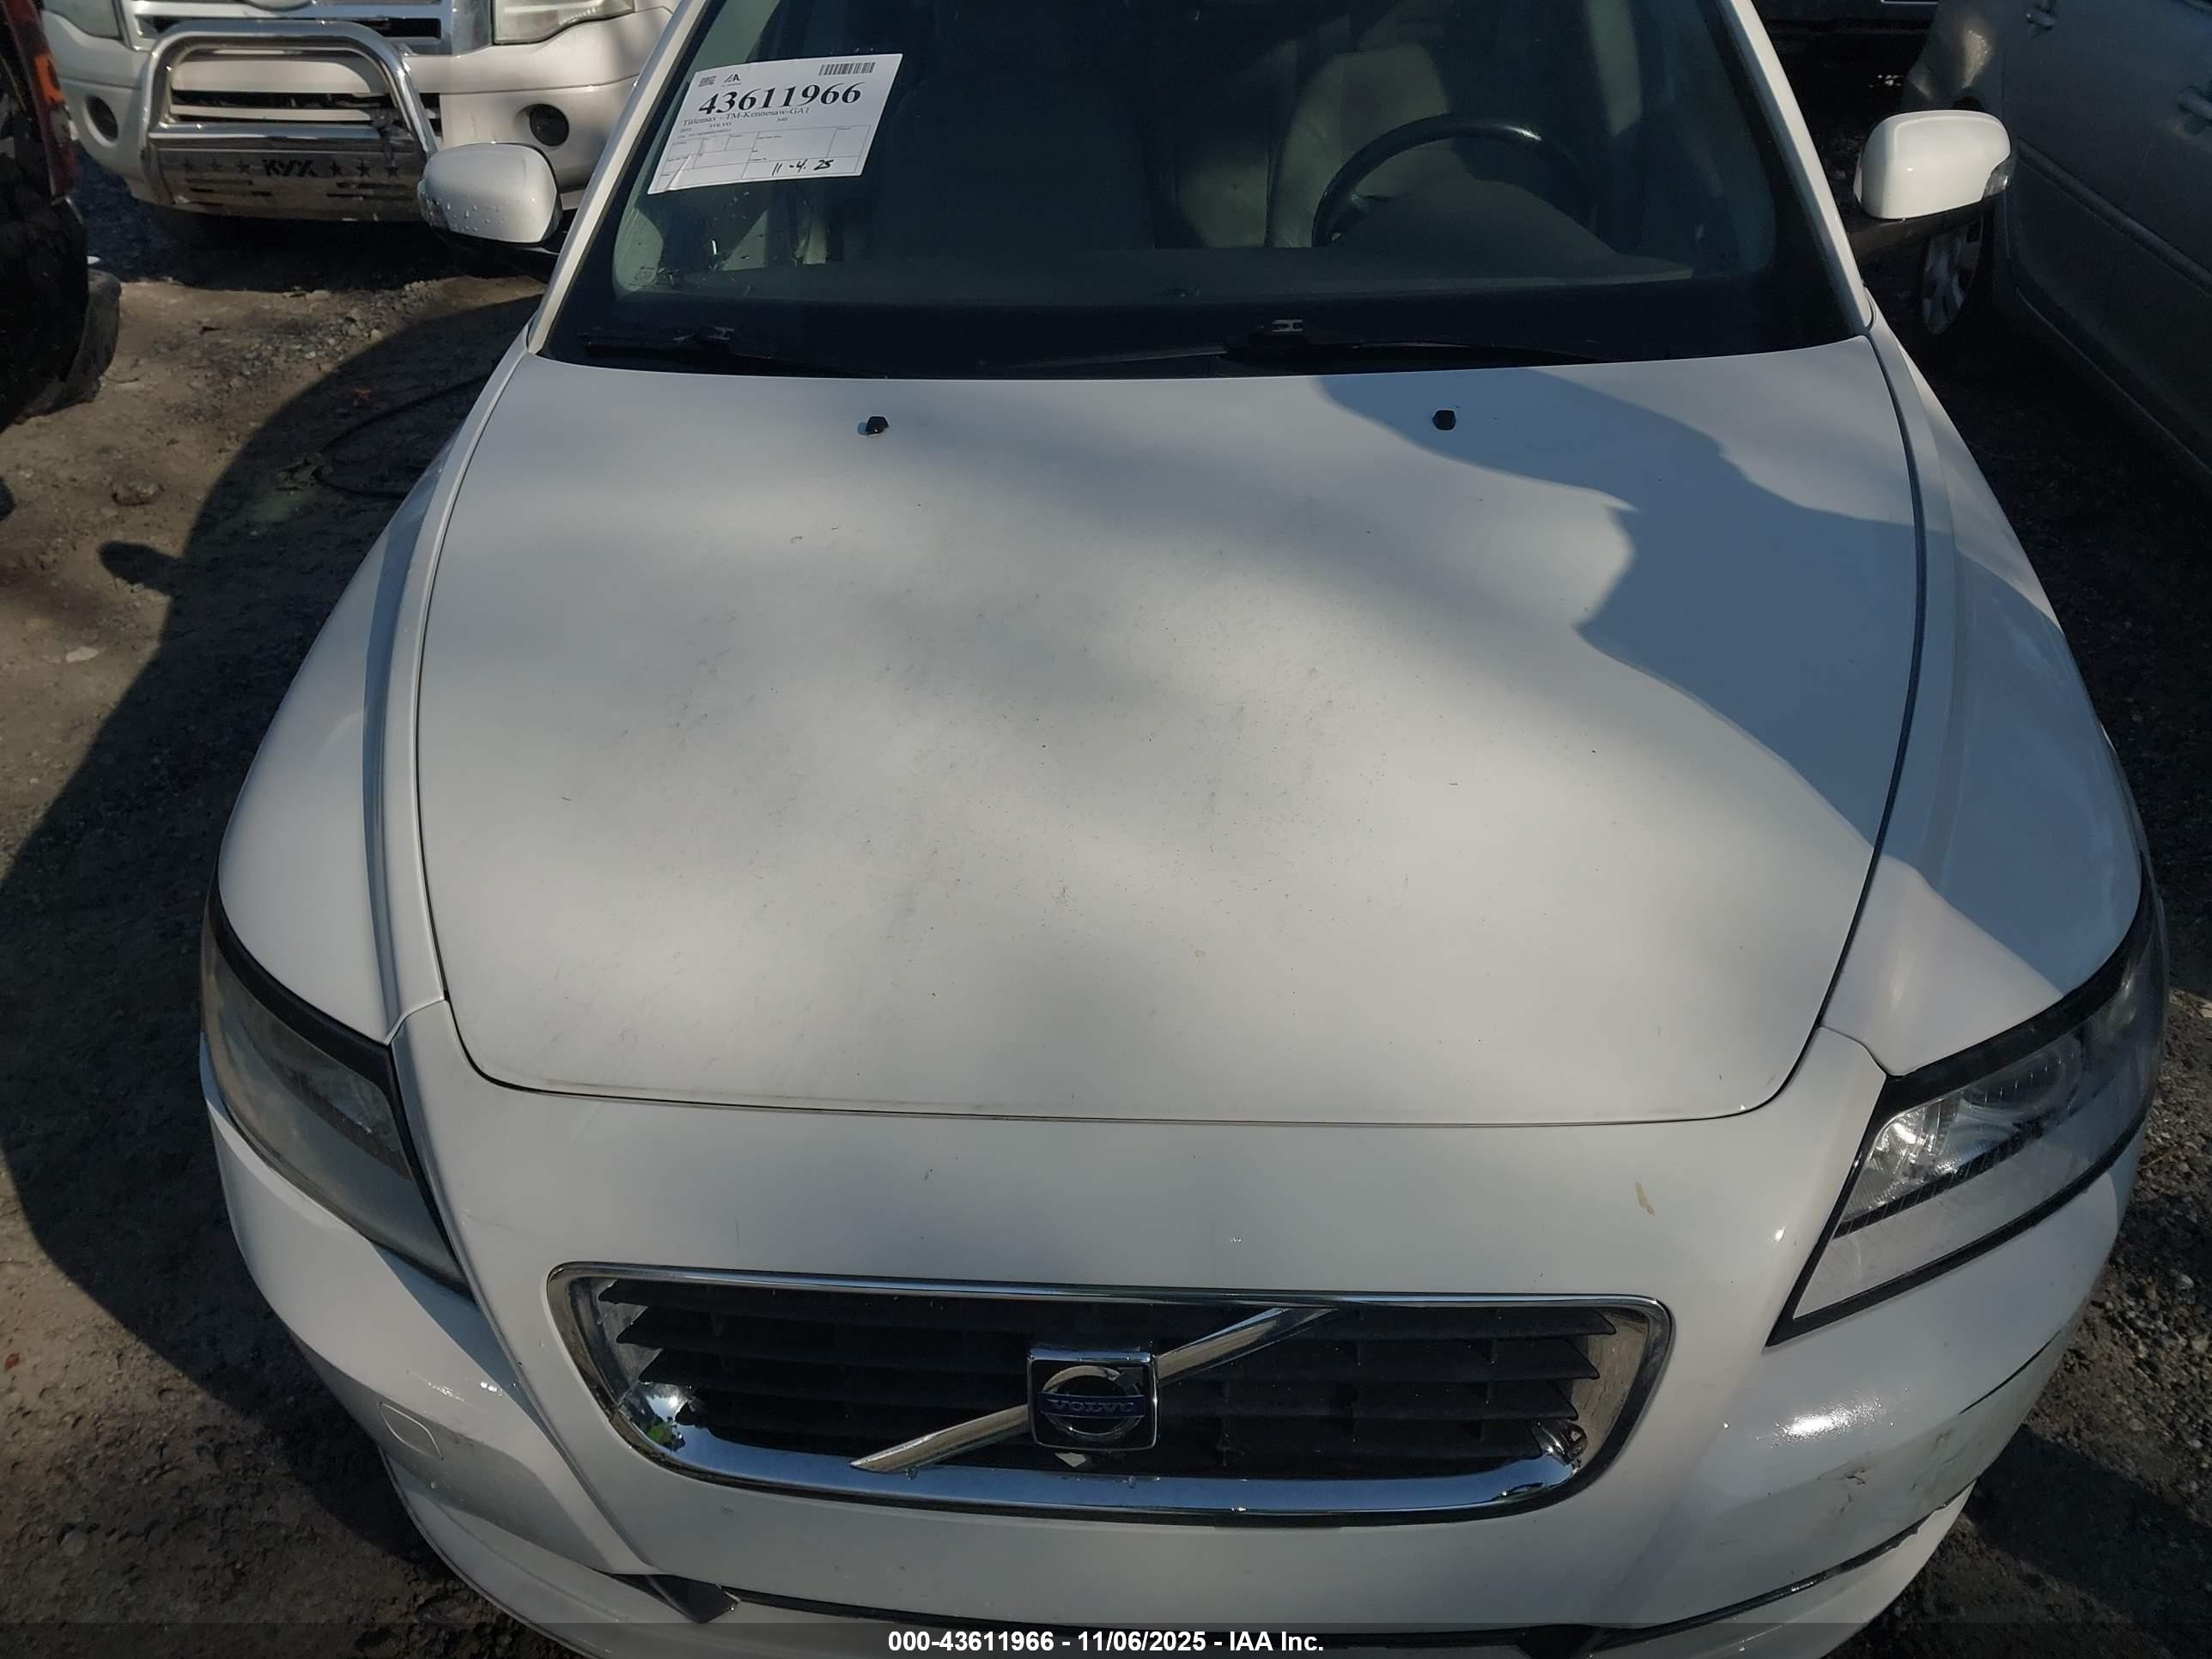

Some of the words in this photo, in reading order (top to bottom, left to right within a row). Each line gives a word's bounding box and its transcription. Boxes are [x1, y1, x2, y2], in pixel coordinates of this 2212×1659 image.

[698, 82, 866, 115] 43611966
[813, 159, 834, 171] 25
[1045, 1398, 1134, 1413] VOLVO
